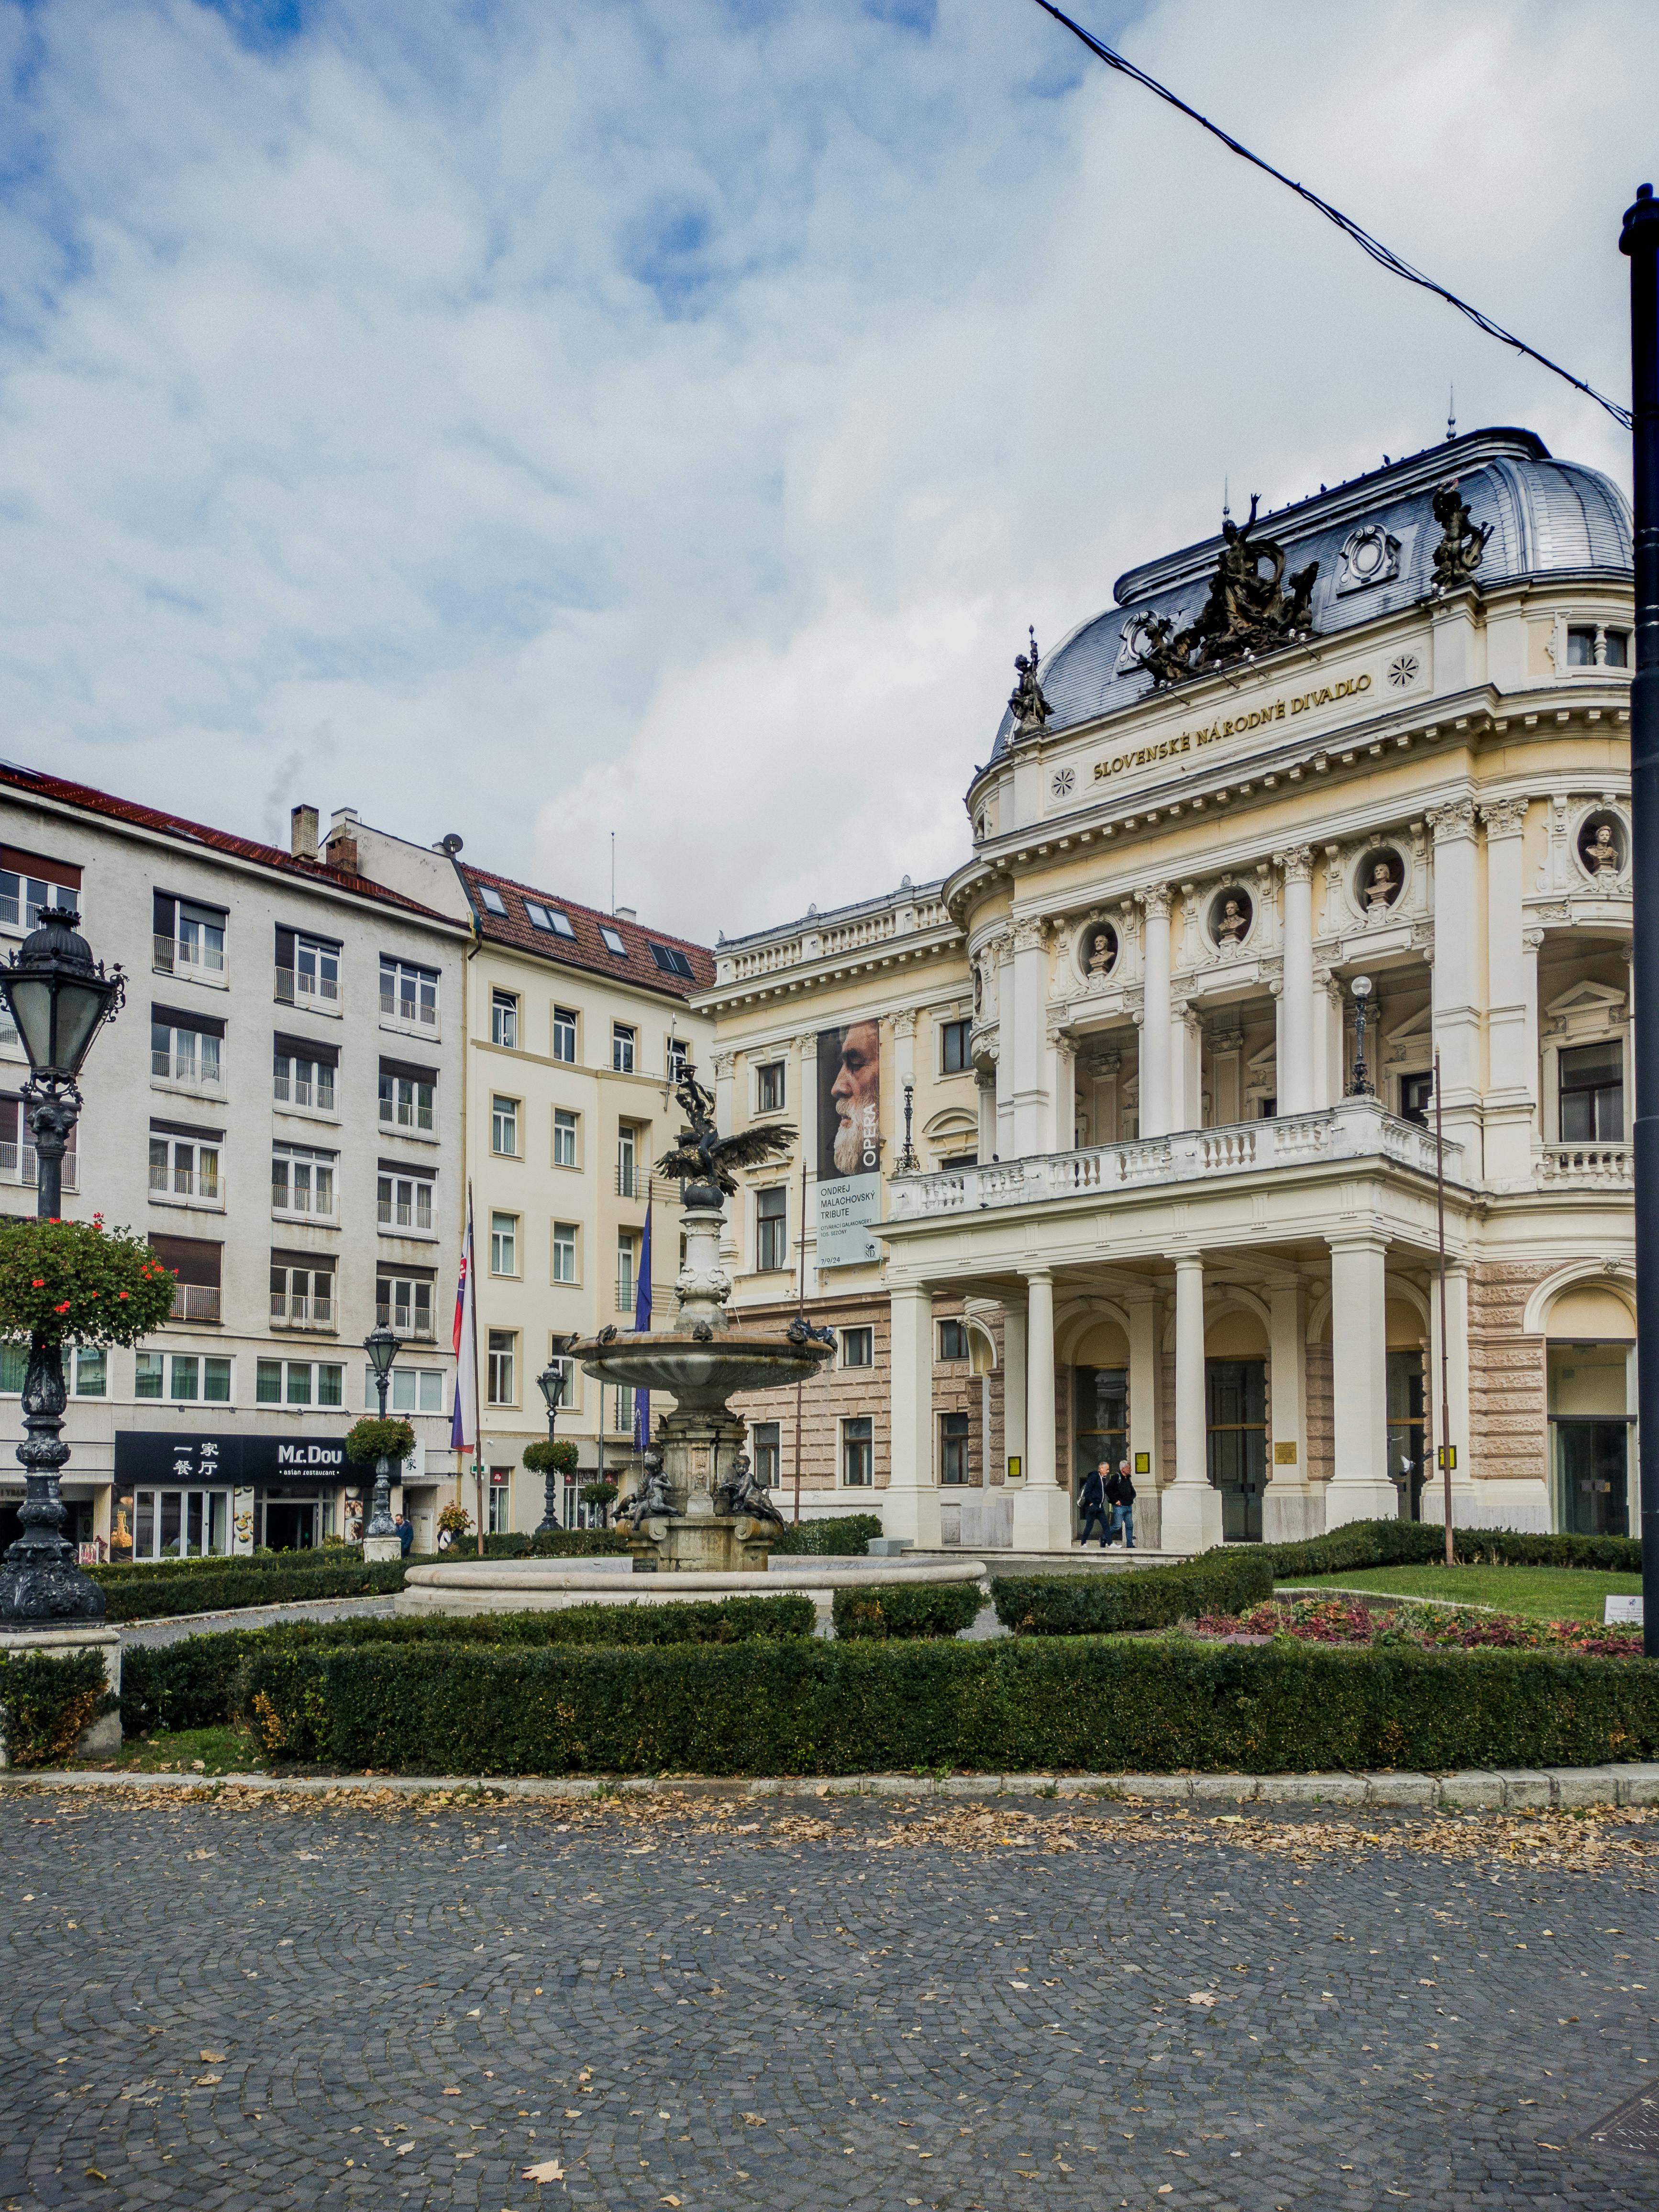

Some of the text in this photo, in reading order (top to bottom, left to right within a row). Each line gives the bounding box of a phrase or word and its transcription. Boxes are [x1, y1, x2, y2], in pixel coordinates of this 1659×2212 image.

[1094, 674, 1372, 780] SLOVENSKÉ NÁRODNÉ DIVADLO
[863, 1103, 876, 1167] OPERA
[820, 1184, 850, 1196] ONDREJ
[821, 1190, 875, 1208] MALACHOVSKÝ
[821, 1208, 850, 1219] TRIBUTE
[820, 1218, 872, 1231] OTVÁRACÍ GALAKONCERT
[820, 1256, 841, 1265] 7/9/24
[174, 1442, 219, 1456] 一家
[173, 1460, 218, 1475] 餐厅
[406, 1458, 417, 1471] 家
